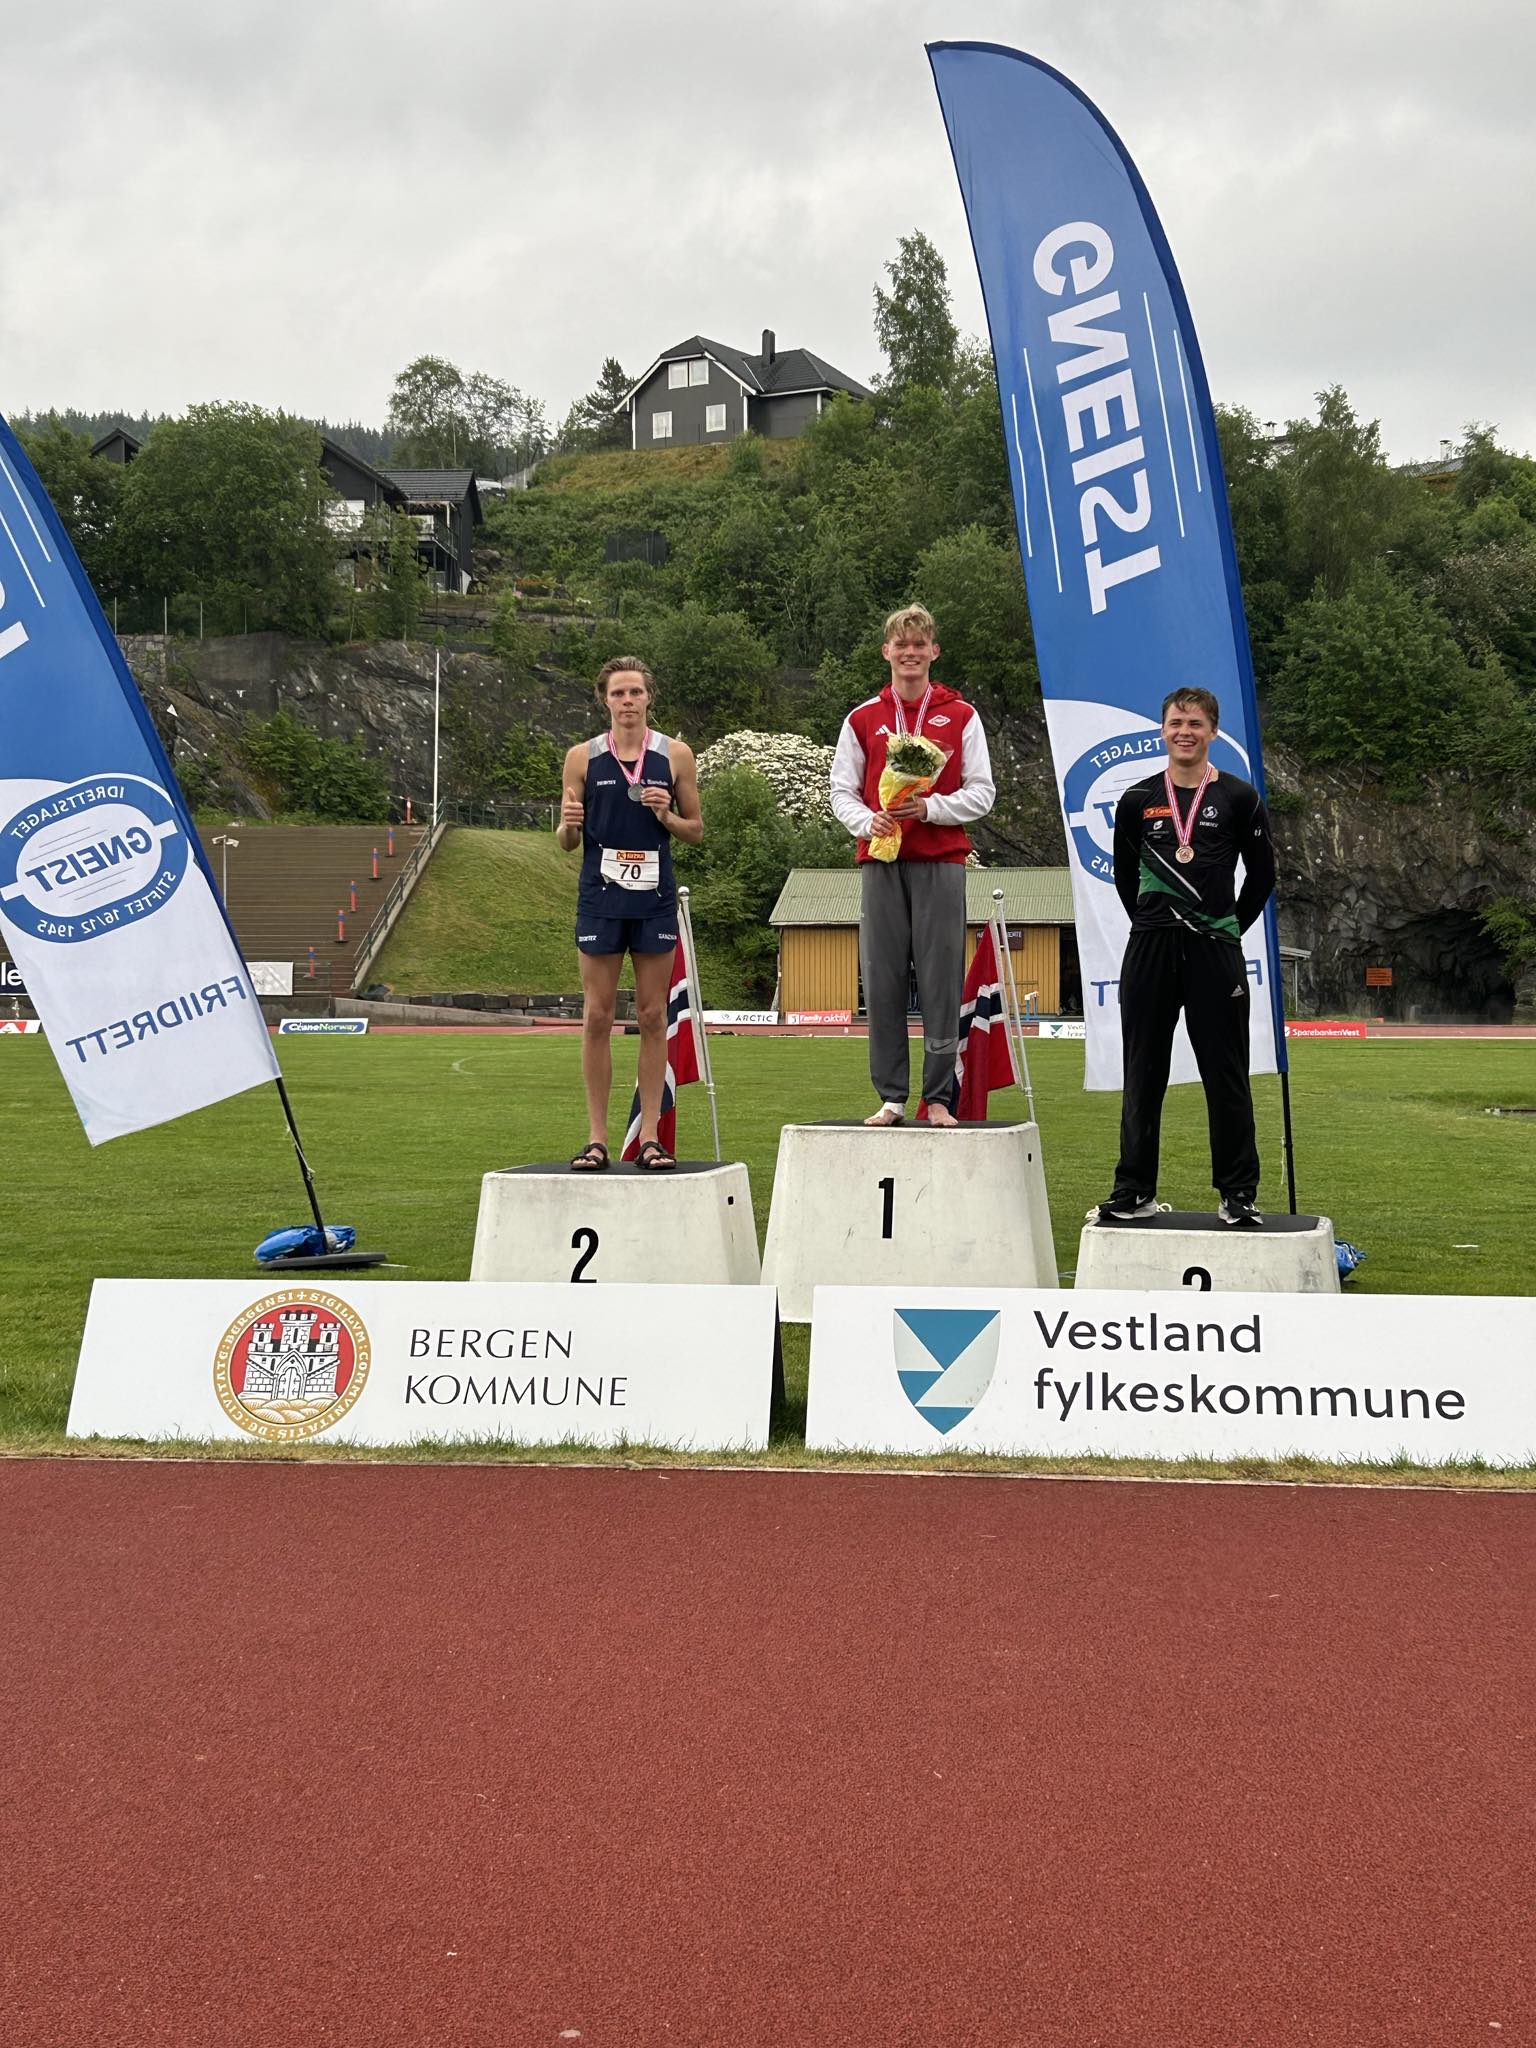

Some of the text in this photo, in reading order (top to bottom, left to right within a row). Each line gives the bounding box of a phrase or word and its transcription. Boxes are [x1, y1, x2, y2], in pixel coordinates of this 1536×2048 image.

[620, 864, 642, 880] 70
[735, 1014, 774, 1023] ARCTIC
[878, 1178, 894, 1239] 1
[571, 1228, 599, 1283] 2
[409, 1328, 573, 1359] BERGEN
[1033, 1310, 1262, 1354] Vestland
[404, 1373, 628, 1407] KOMMUNE
[1033, 1366, 1466, 1422] fylkeskommune
